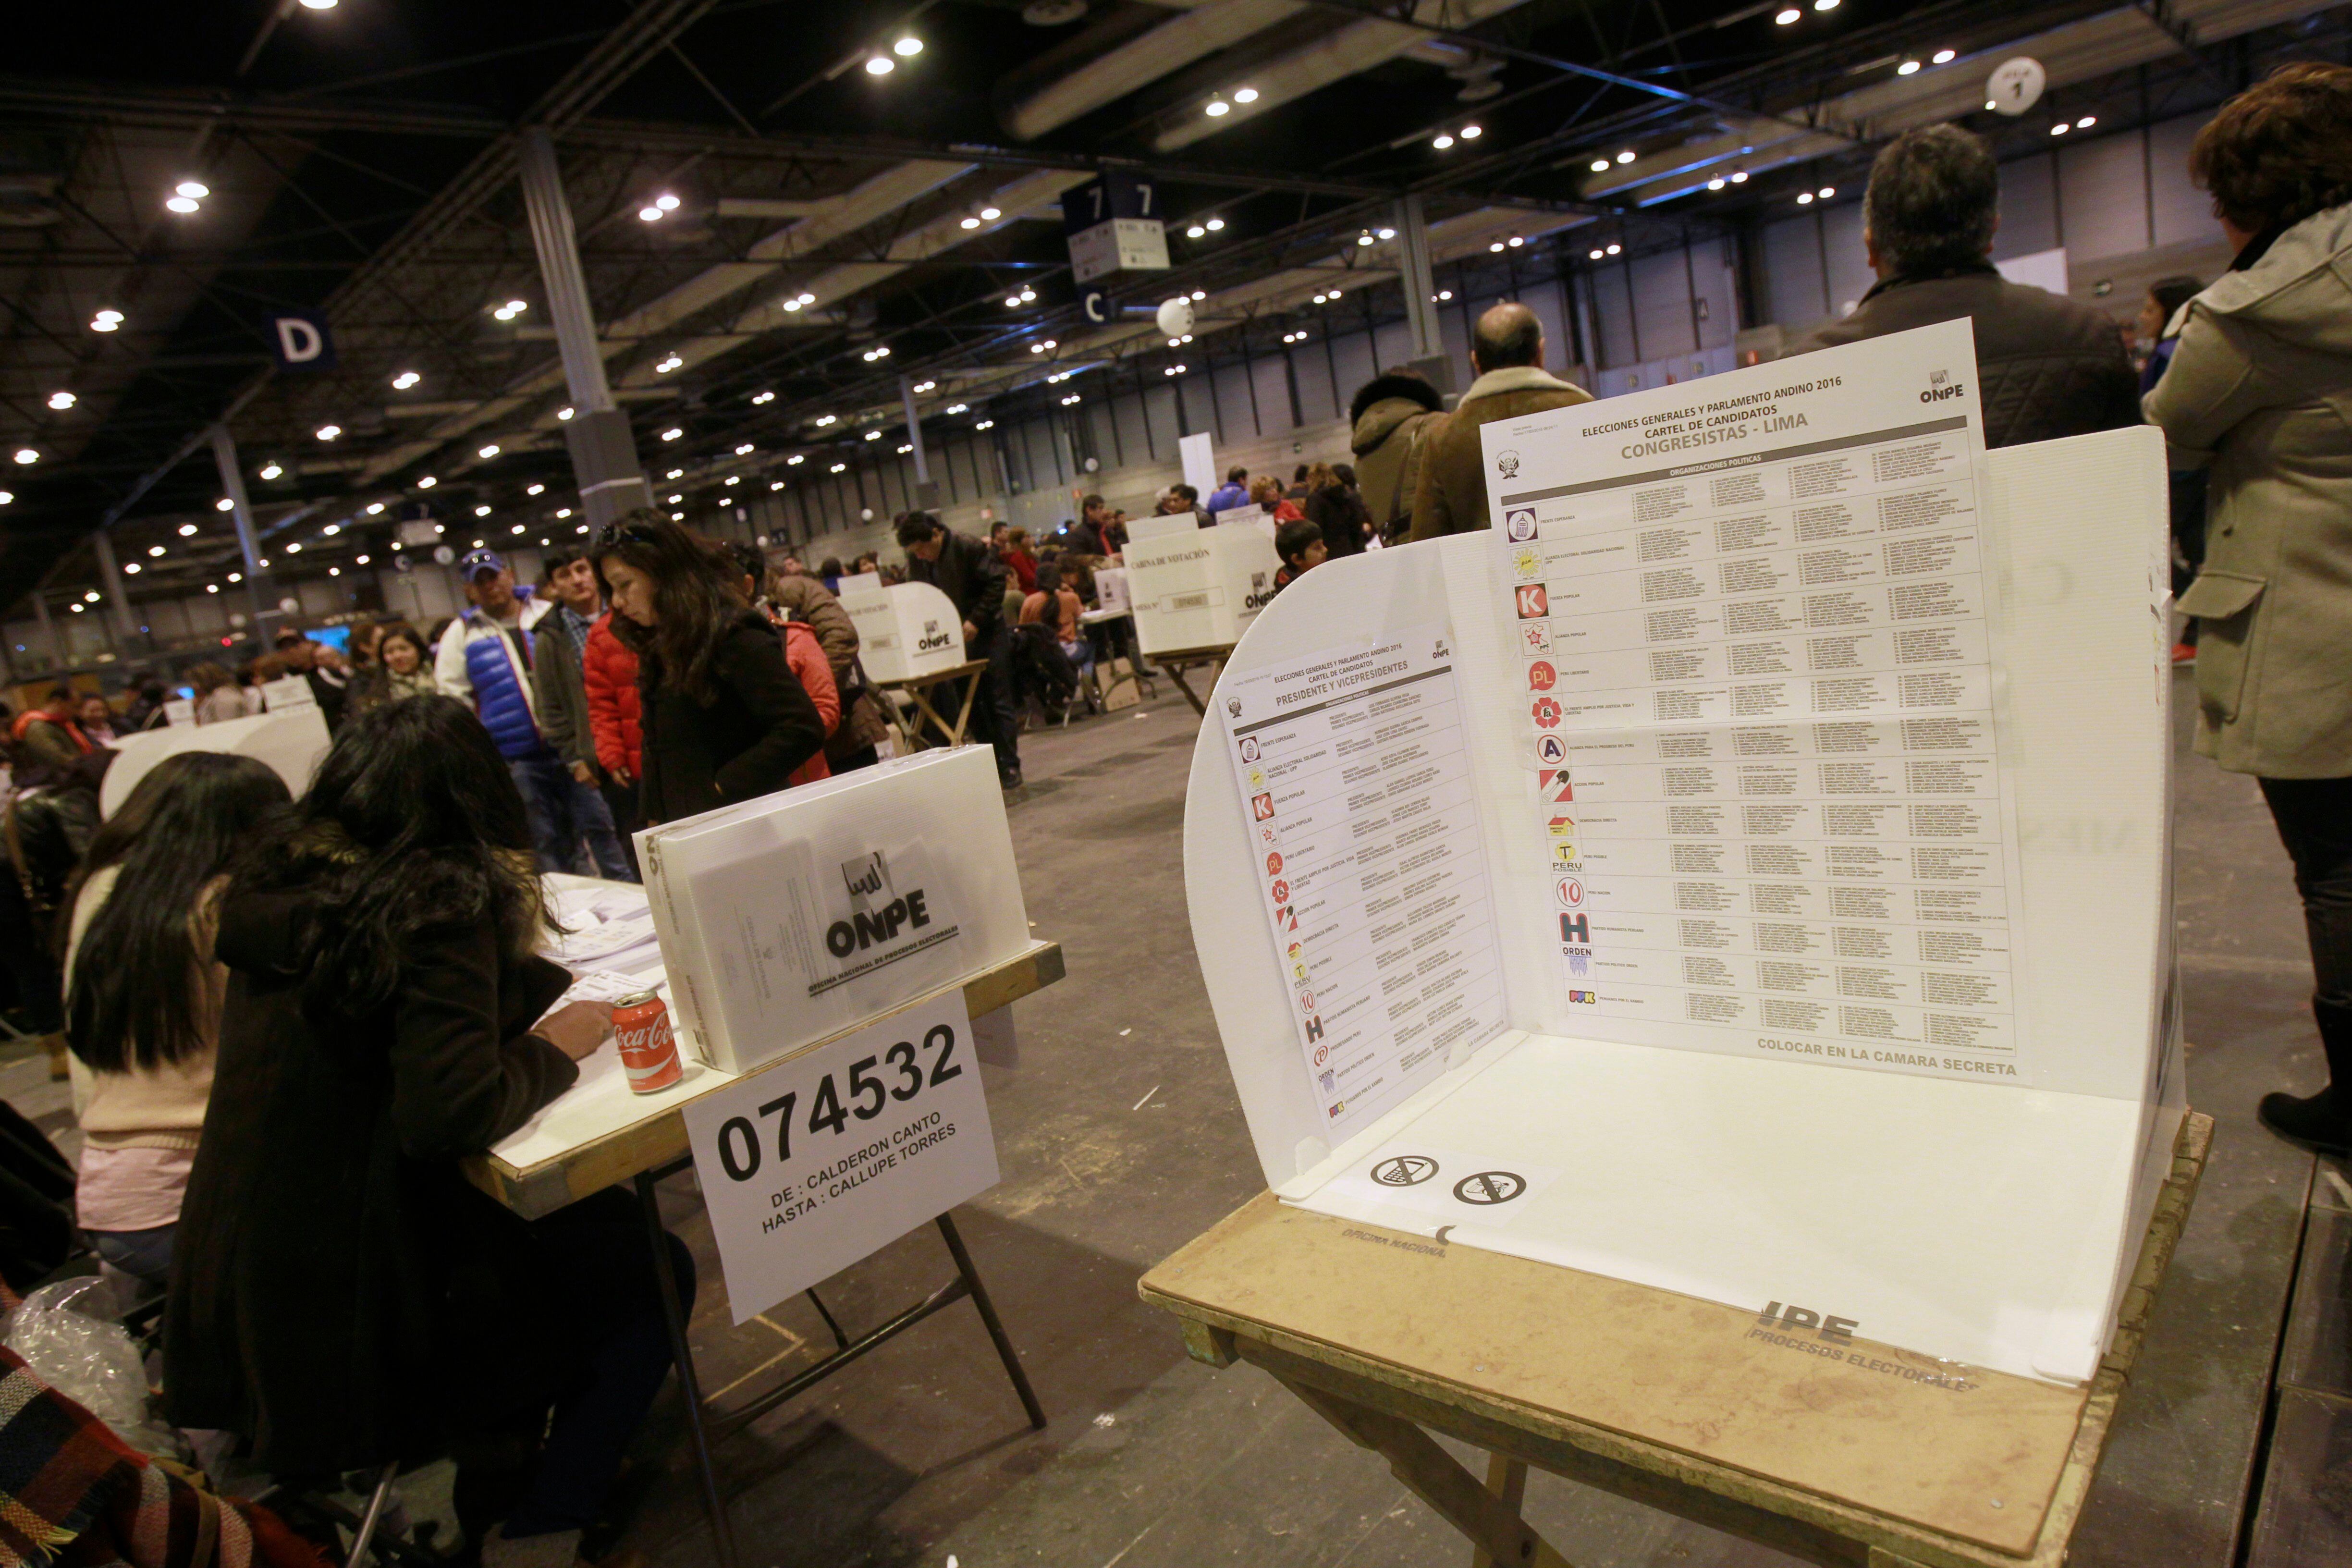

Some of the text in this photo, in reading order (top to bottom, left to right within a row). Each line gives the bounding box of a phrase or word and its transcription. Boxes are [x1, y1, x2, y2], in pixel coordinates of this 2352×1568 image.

[1089, 186, 1102, 219] 7
[1137, 184, 1152, 216] 7
[1085, 292, 1104, 322] C
[276, 318, 323, 363] D
[1920, 384, 1964, 403] ONPE
[1582, 376, 1841, 437] ELECCIONES GENERALES Y PARLAMENTO ANDINO 2016
[1644, 405, 1777, 439] CARTEL DE CANDIDATOS
[1621, 424, 1747, 460] CONGRESISTAS
[1763, 412, 1808, 433] LIMA
[1670, 454, 1761, 476] ORGANIZACIONES POLITICAS
[1131, 548, 1210, 570] CABINA DE VOTACIÓN
[1520, 589, 1543, 614] K
[919, 633, 950, 650] ONPE
[1274, 670, 1305, 683] ELECCIONES
[1305, 662, 1333, 674] GENERALES
[1337, 651, 1370, 665] PARLAMENTO
[1370, 646, 1390, 656] ANDINO
[1389, 643, 1402, 651] 2016
[1433, 649, 1449, 659] ONPE
[1275, 660, 1409, 706] PRESIDENTE Y VICEPRESIDENTES
[1308, 672, 1329, 683] CARTEL
[1338, 660, 1373, 674] CANDIDATOS
[1260, 733, 1296, 747] FRENTE ESPERANZA
[1544, 739, 1561, 757] A
[1267, 750, 1326, 773] ALIANZA ELECTORAL SOLIDARIDAD
[1268, 769, 1287, 779] NACIONAL
[1255, 797, 1270, 817] K
[1274, 790, 1305, 805] FUERZA POPULAR
[1279, 817, 1312, 833] ALIANZA POPULAR
[1295, 845, 1315, 857] LIBERTARIO
[1294, 874, 1307, 883] FRENTE
[1308, 869, 1322, 878] AMPLIO
[1329, 859, 1346, 869] JUSTICIA,
[1294, 880, 1311, 890] LIBERTAD
[1560, 882, 1580, 903] 10
[1297, 899, 1325, 916] ACCION POPULAR
[826, 889, 930, 958] ONPE
[1303, 923, 1338, 943] DEMOCRACIA DIRECTA
[1559, 912, 1590, 943] H
[808, 925, 958, 993] OFICINA NACIONAL DE PROCESOS ELECTORALES
[1563, 947, 1592, 956] ORDEN
[1309, 956, 1332, 971] PERU POSIBLE
[1294, 975, 1311, 987] PERU
[1316, 983, 1338, 998] PERU NACION
[1301, 992, 1314, 1011] 10
[1569, 990, 1595, 1004] PPK
[1323, 995, 1370, 1025] PARTIDO HUMANISTA PERUANO
[1305, 1015, 1324, 1044] H
[1329, 1030, 1361, 1052] PROGRESANDO PERU
[1474, 1031, 1488, 1043] CAMARA
[1489, 1020, 1504, 1033] SECRETA
[1336, 1052, 1374, 1078] PARTIDO POLITICO ORDEN
[1758, 1038, 2016, 1076] COLOCAR EN LA CAMARA SECRETA
[1318, 1067, 1335, 1082] ORDEN
[1345, 1090, 1361, 1105] PERUANOS
[1371, 1076, 1383, 1088] KAMBIO
[717, 1024, 962, 1182] 074532
[771, 1186, 793, 1209] DE
[806, 1138, 890, 1190] CALDERON
[892, 1110, 941, 1145] CANTO
[762, 1195, 816, 1234] HASTA
[828, 1153, 897, 1199] CALLUPE
[901, 1122, 956, 1160] TORRES
[1342, 1228, 1446, 1258] OFICINA NACIONAL
[1751, 1329, 1980, 1393] PROCESOS ELECTORALES
